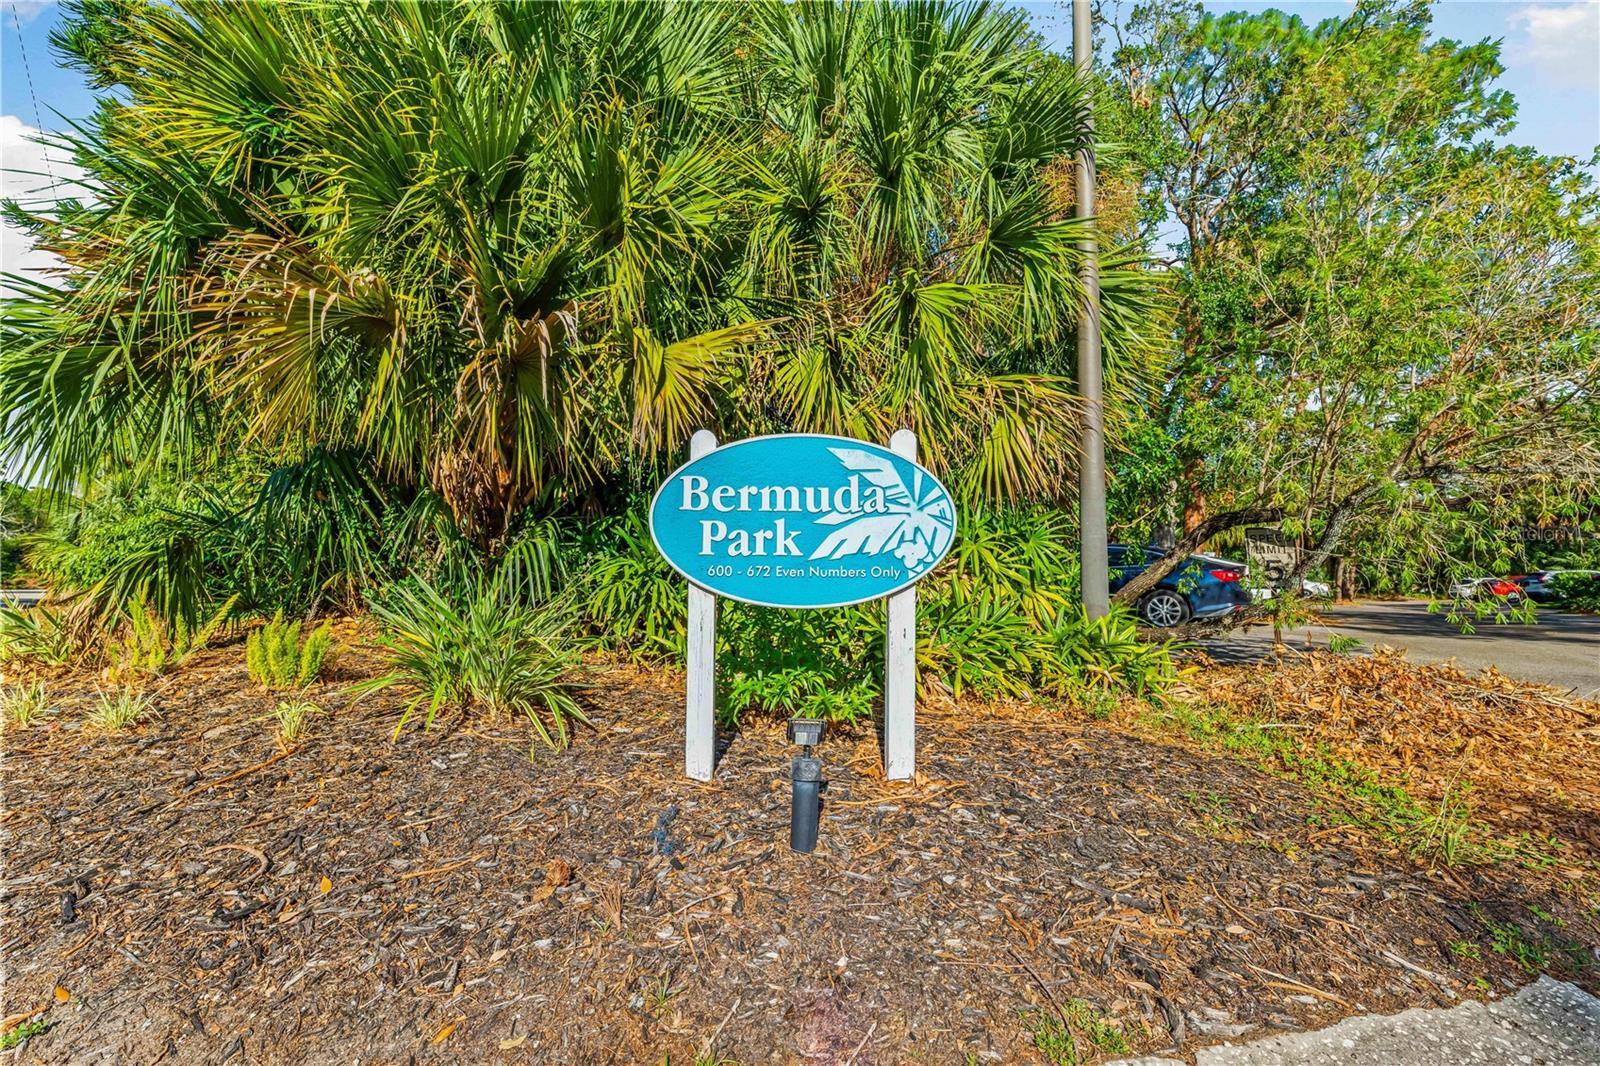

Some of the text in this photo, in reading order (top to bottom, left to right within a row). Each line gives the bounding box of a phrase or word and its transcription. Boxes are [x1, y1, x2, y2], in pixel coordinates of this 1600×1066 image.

[679, 474, 889, 515] Bermuda
[698, 518, 804, 557] Park
[1249, 533, 1292, 545] SPEE
[1255, 544, 1287, 555] LIMIT
[707, 565, 733, 578] 600
[746, 565, 771, 578] 672
[775, 566, 805, 578] Even
[809, 565, 867, 578] Numbers
[870, 565, 901, 581] Only
